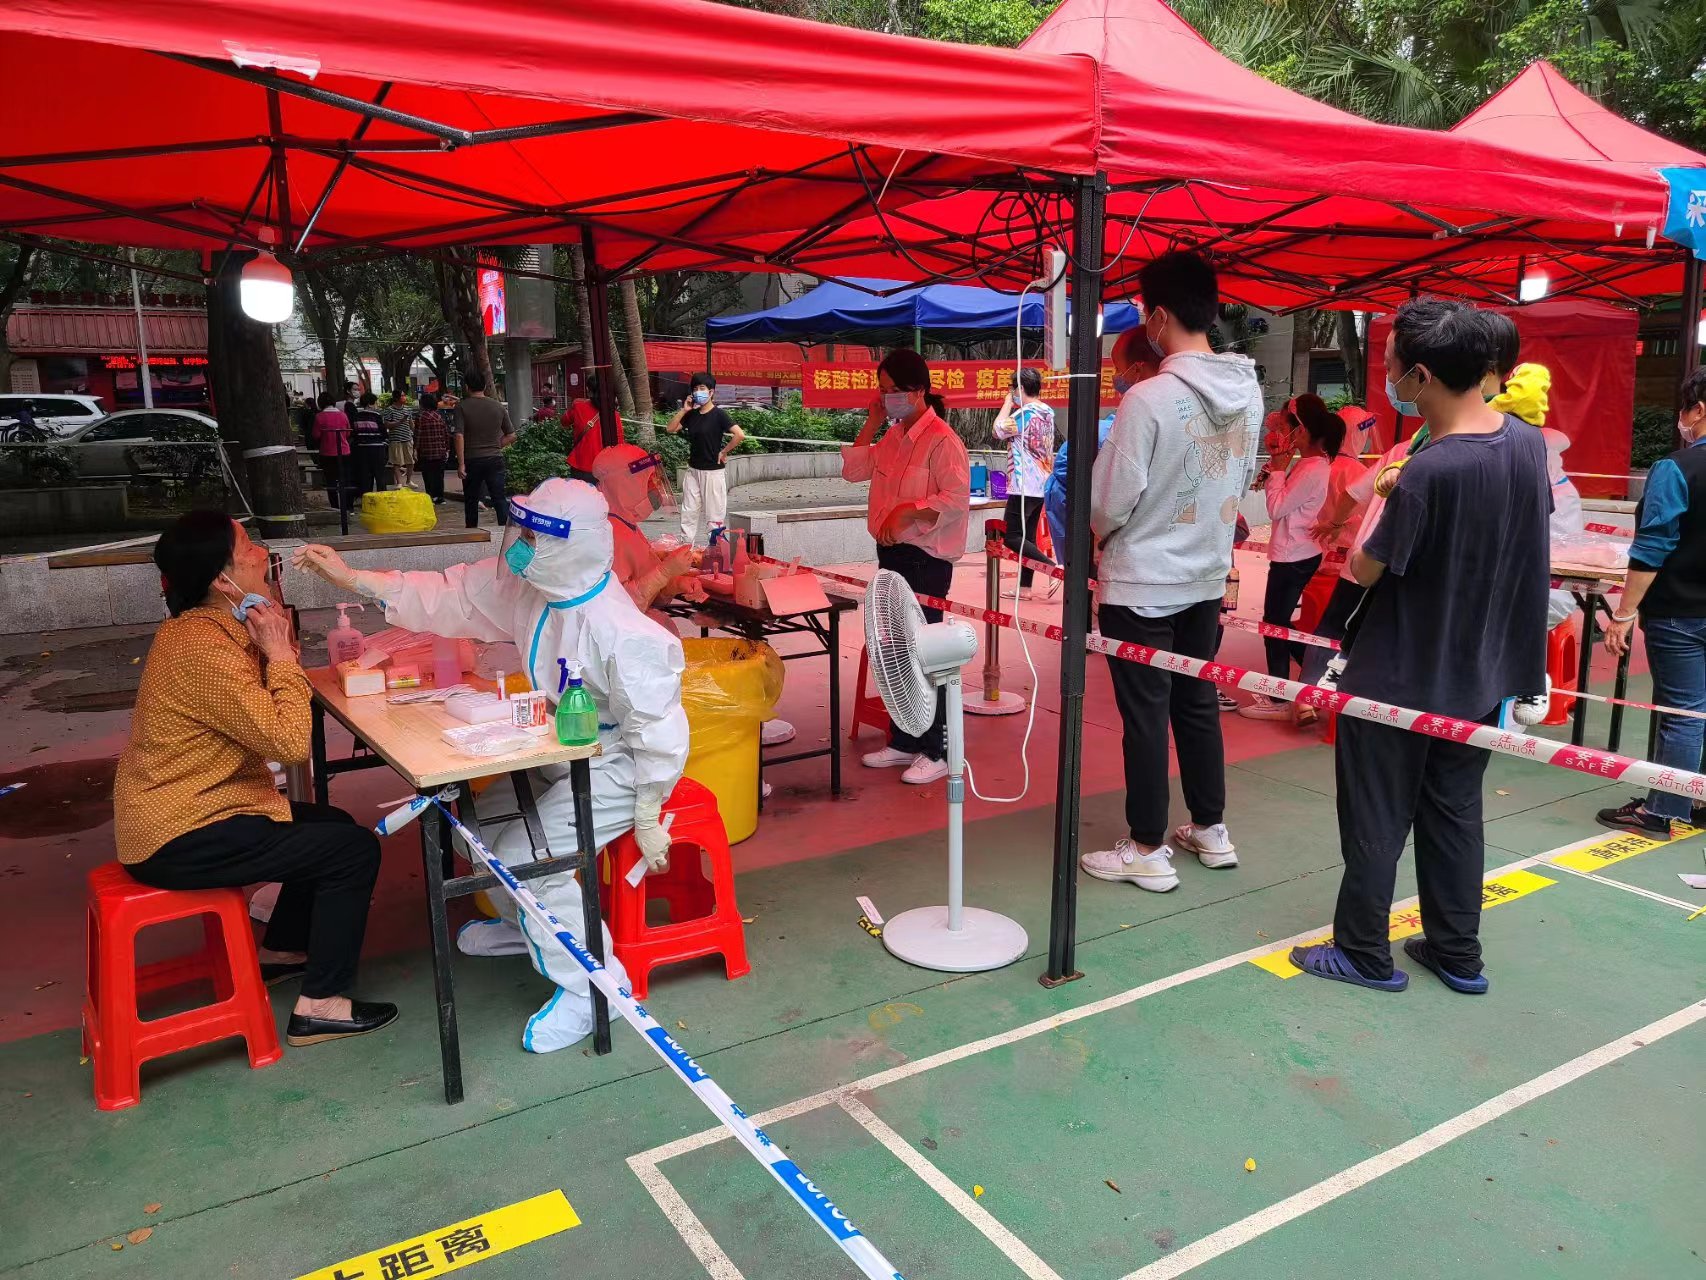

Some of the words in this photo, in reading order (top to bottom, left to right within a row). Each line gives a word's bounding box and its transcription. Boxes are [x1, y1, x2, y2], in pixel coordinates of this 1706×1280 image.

[1167, 655, 1191, 668] 注意
[1210, 666, 1236, 680] 安全
[1253, 684, 1286, 697] CAUTION
[1259, 676, 1287, 690] 注意
[1305, 696, 1335, 709] SAFE
[1311, 689, 1340, 704] 安全
[1360, 709, 1399, 724] CAUTION
[1368, 703, 1401, 717] 注意
[1422, 724, 1458, 738] SAFE
[1430, 717, 1465, 733] 安全
[1489, 740, 1536, 757] CAUTION
[1498, 733, 1538, 749] 注意
[1564, 757, 1609, 774] SAFE
[1574, 750, 1616, 768] 安全
[1647, 776, 1704, 796] CAUTION
[1658, 769, 1706, 788] 注意
